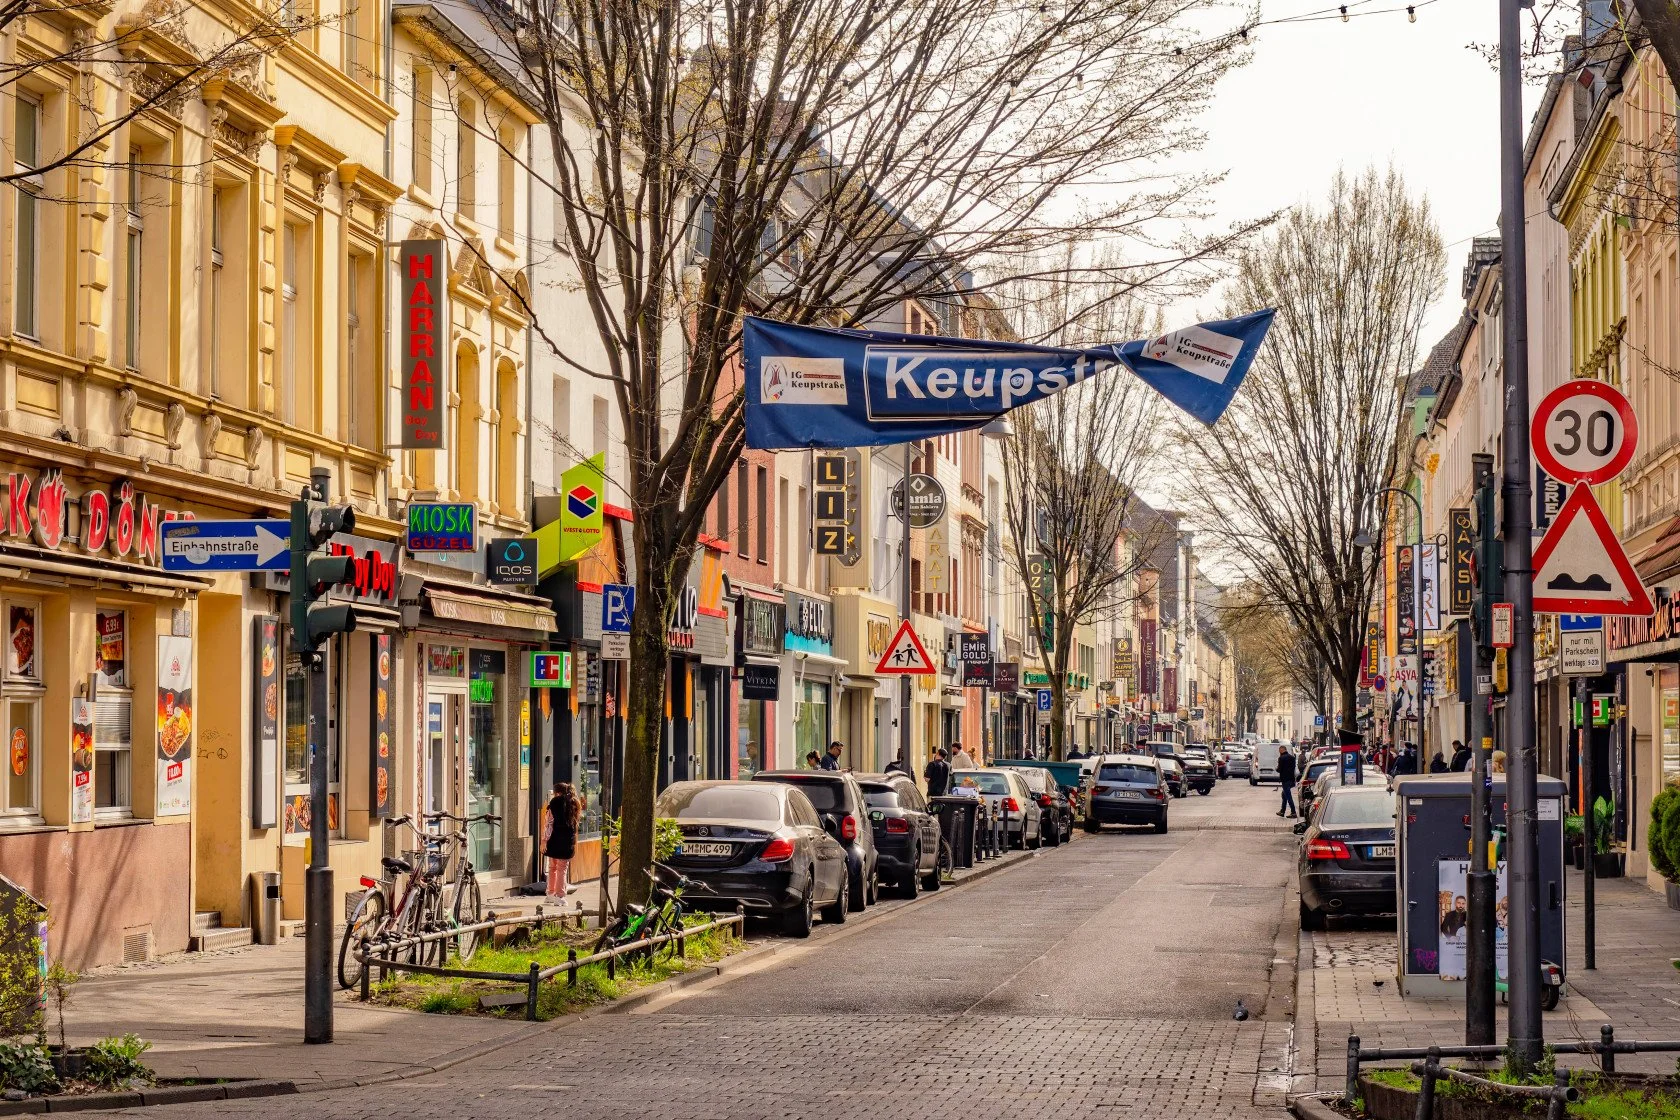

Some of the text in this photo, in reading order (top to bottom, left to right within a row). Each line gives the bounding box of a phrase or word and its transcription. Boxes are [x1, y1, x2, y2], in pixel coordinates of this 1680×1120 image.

[409, 254, 435, 411] HARRAN
[1179, 336, 1192, 348] IG
[1176, 345, 1231, 369] Keupstraße
[791, 371, 802, 379] IG
[791, 380, 845, 390] Keupstraße
[1553, 409, 1614, 457] 30
[87, 480, 196, 566] DÖN
[410, 506, 473, 532] KIOSK
[172, 540, 259, 552] Einbahnstraße
[411, 535, 473, 549] GÜZEL
[496, 565, 532, 576] IQOS
[1457, 530, 1471, 604] AKSU
[607, 590, 625, 626] P
[962, 652, 987, 660] GOLD
[1369, 640, 1378, 674] Damla
[1565, 648, 1599, 656] Parkschein
[1396, 670, 1417, 681] ASYA
[1345, 753, 1353, 764] P
[681, 844, 731, 854] LM MC 499
[1375, 846, 1388, 856] LM
